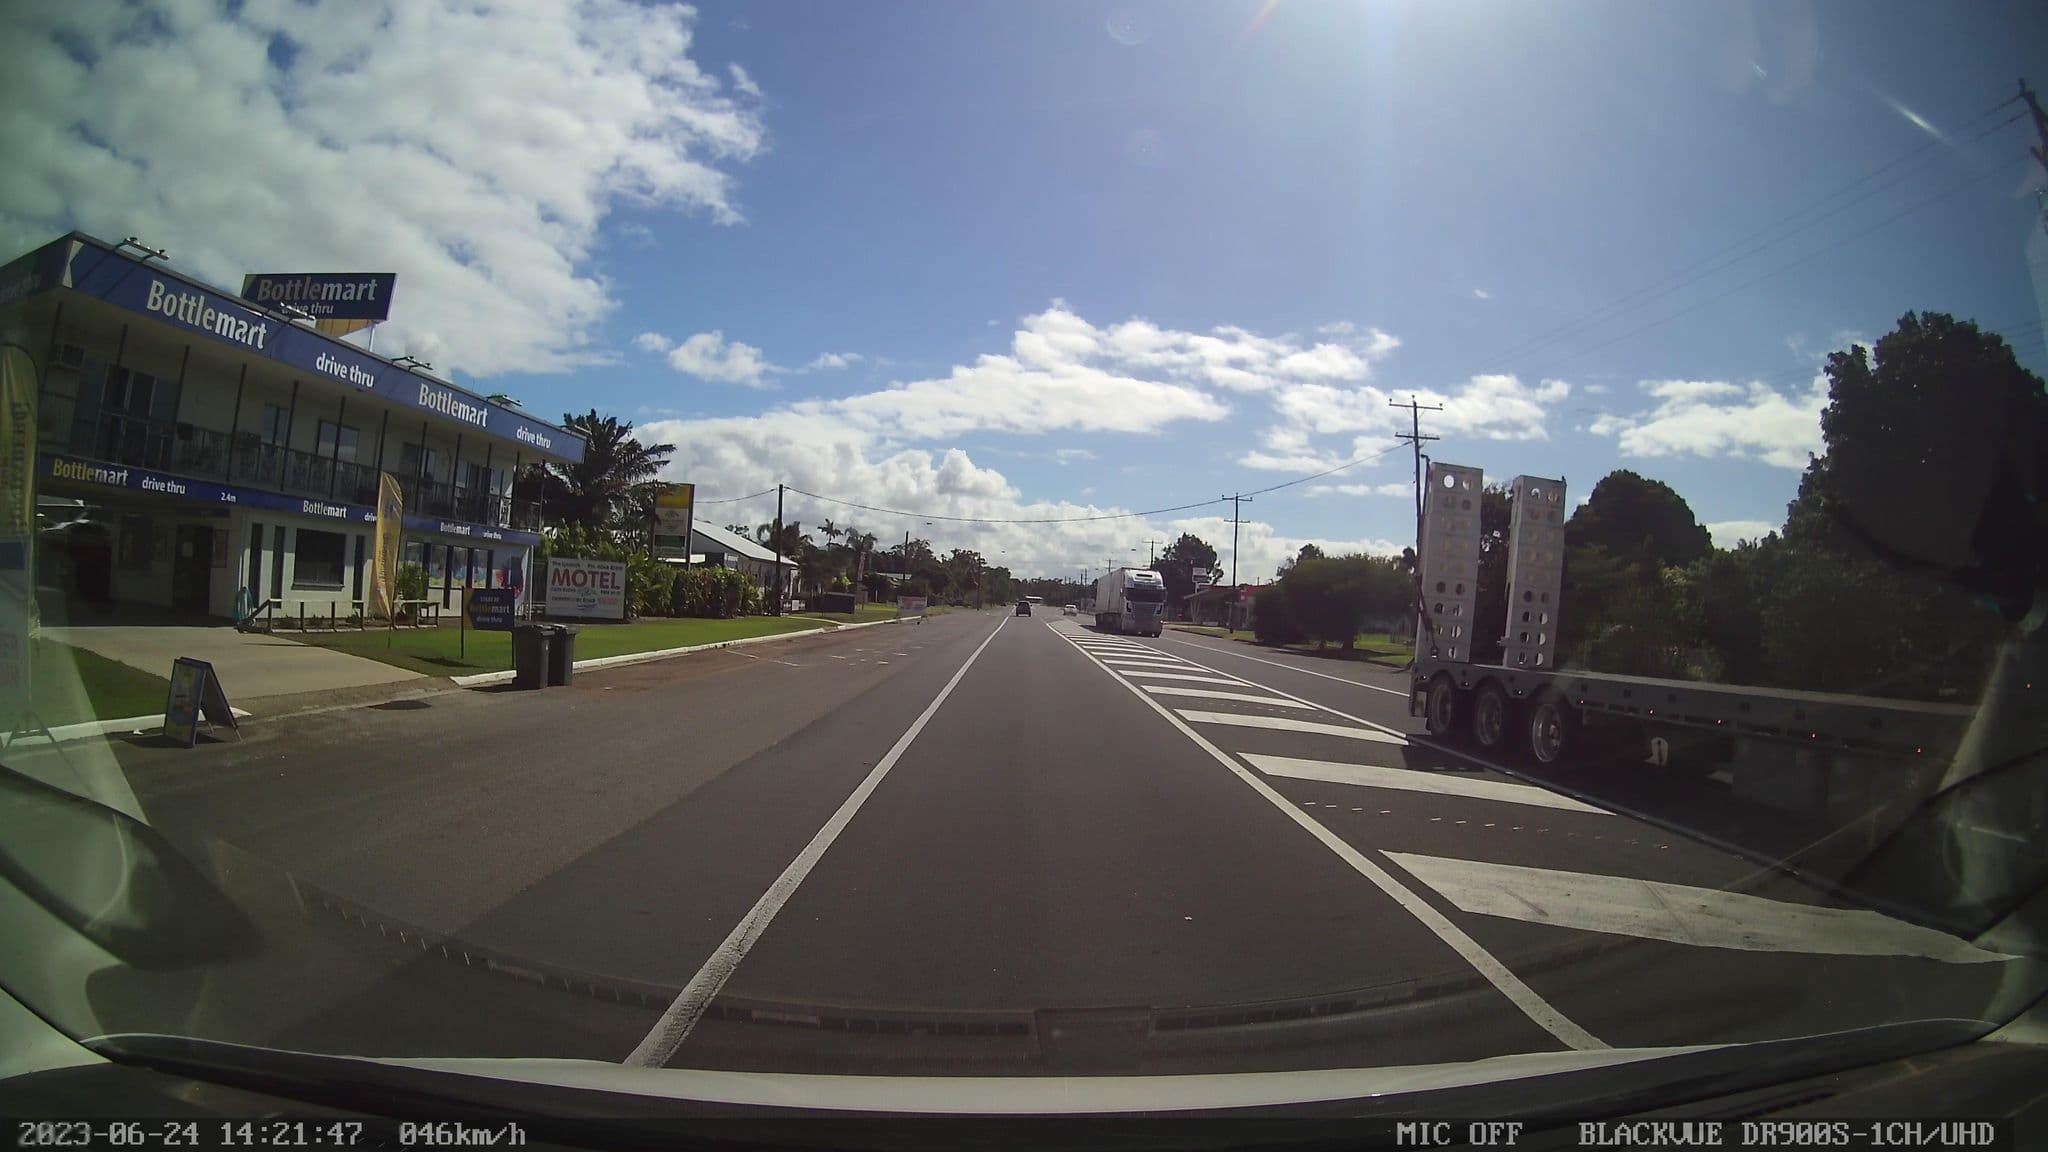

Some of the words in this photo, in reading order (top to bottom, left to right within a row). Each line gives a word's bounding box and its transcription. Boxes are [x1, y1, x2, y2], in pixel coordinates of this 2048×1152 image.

[257, 276, 378, 301] Bottlemart
[281, 302, 309, 315] ive
[311, 302, 334, 315] thru
[146, 279, 268, 350] Bottlemart
[315, 352, 348, 379] drive
[349, 364, 375, 390] thru
[418, 382, 489, 429] Bottlemart
[516, 425, 536, 443] drive
[536, 433, 551, 449] thru
[53, 458, 128, 487] Bottlemart
[142, 476, 166, 492] drive
[167, 480, 186, 495] thru
[221, 492, 237, 503] 2.4m
[303, 500, 347, 519] Bottlemart
[364, 512, 377, 522] driv
[440, 521, 471, 536] Bottlemart
[551, 567, 621, 590] MOTEL
